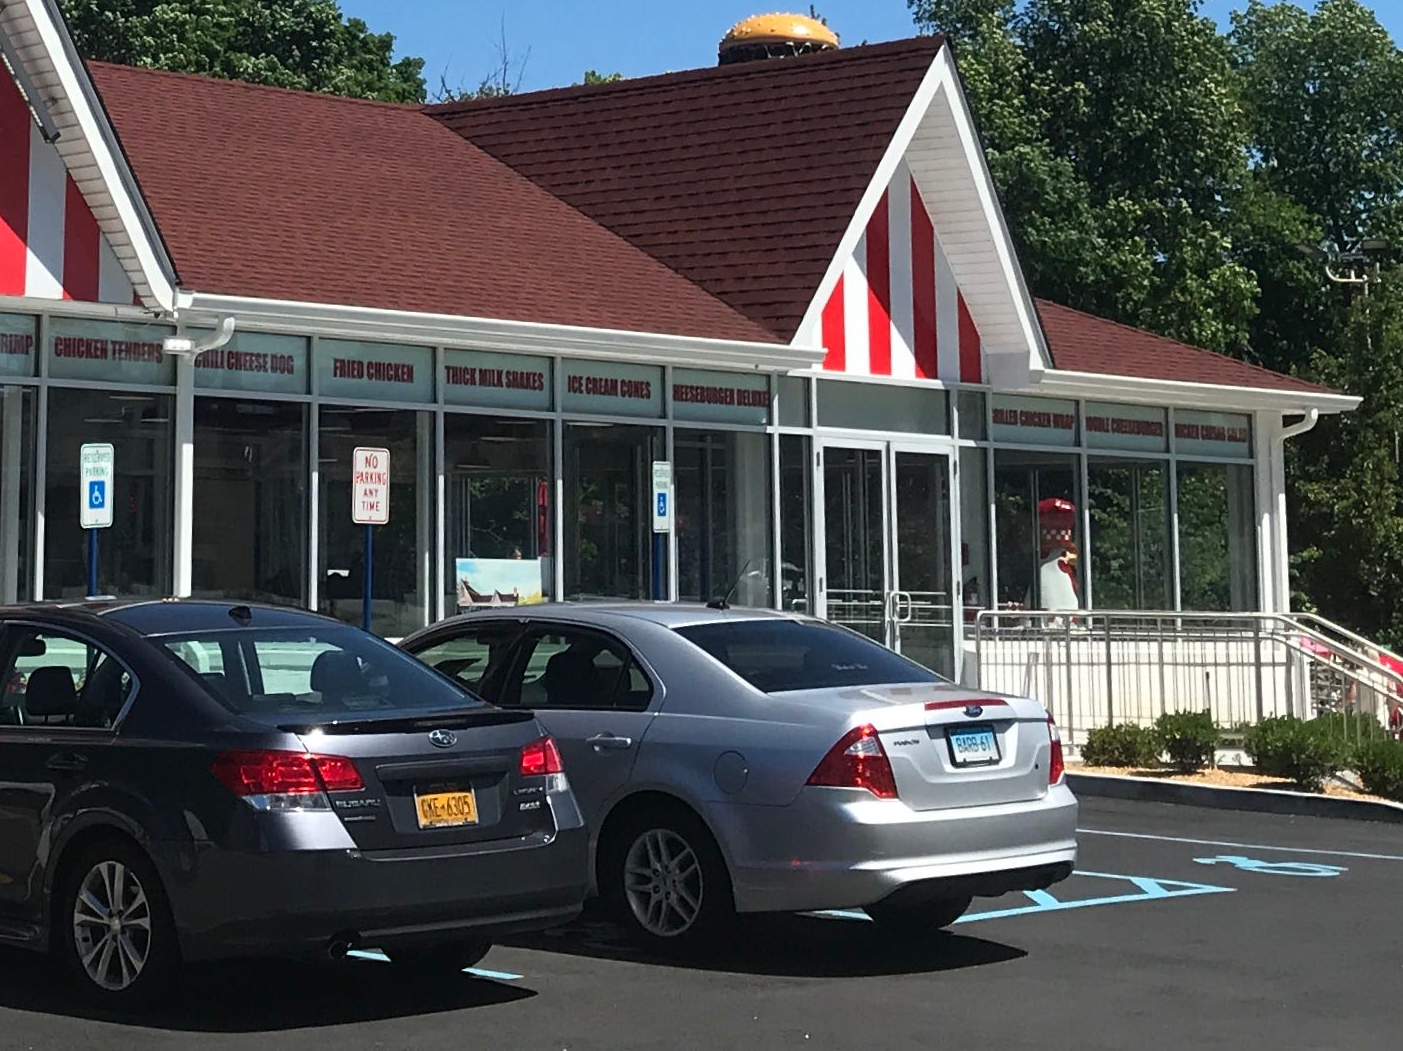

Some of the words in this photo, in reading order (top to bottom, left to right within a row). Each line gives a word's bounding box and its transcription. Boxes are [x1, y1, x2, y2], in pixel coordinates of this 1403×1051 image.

[54, 335, 108, 360] CHICKEN
[111, 340, 163, 364] TENDERS
[194, 349, 224, 370] CHILI
[226, 350, 268, 374] CHEESE
[271, 354, 295, 375] DOG
[332, 358, 364, 379] FRIED
[366, 361, 414, 384] CHICKEN
[445, 366, 476, 386] THICK
[478, 368, 504, 388] MILK
[505, 371, 545, 392] SHAKES
[567, 375, 584, 394] ICE
[585, 377, 618, 397] CREAM
[620, 379, 651, 399] CONES
[85, 466, 109, 477] PARKING
[364, 455, 379, 469] NO
[356, 473, 386, 486] PARKING
[363, 488, 379, 498] ANY
[361, 501, 380, 512] TIME
